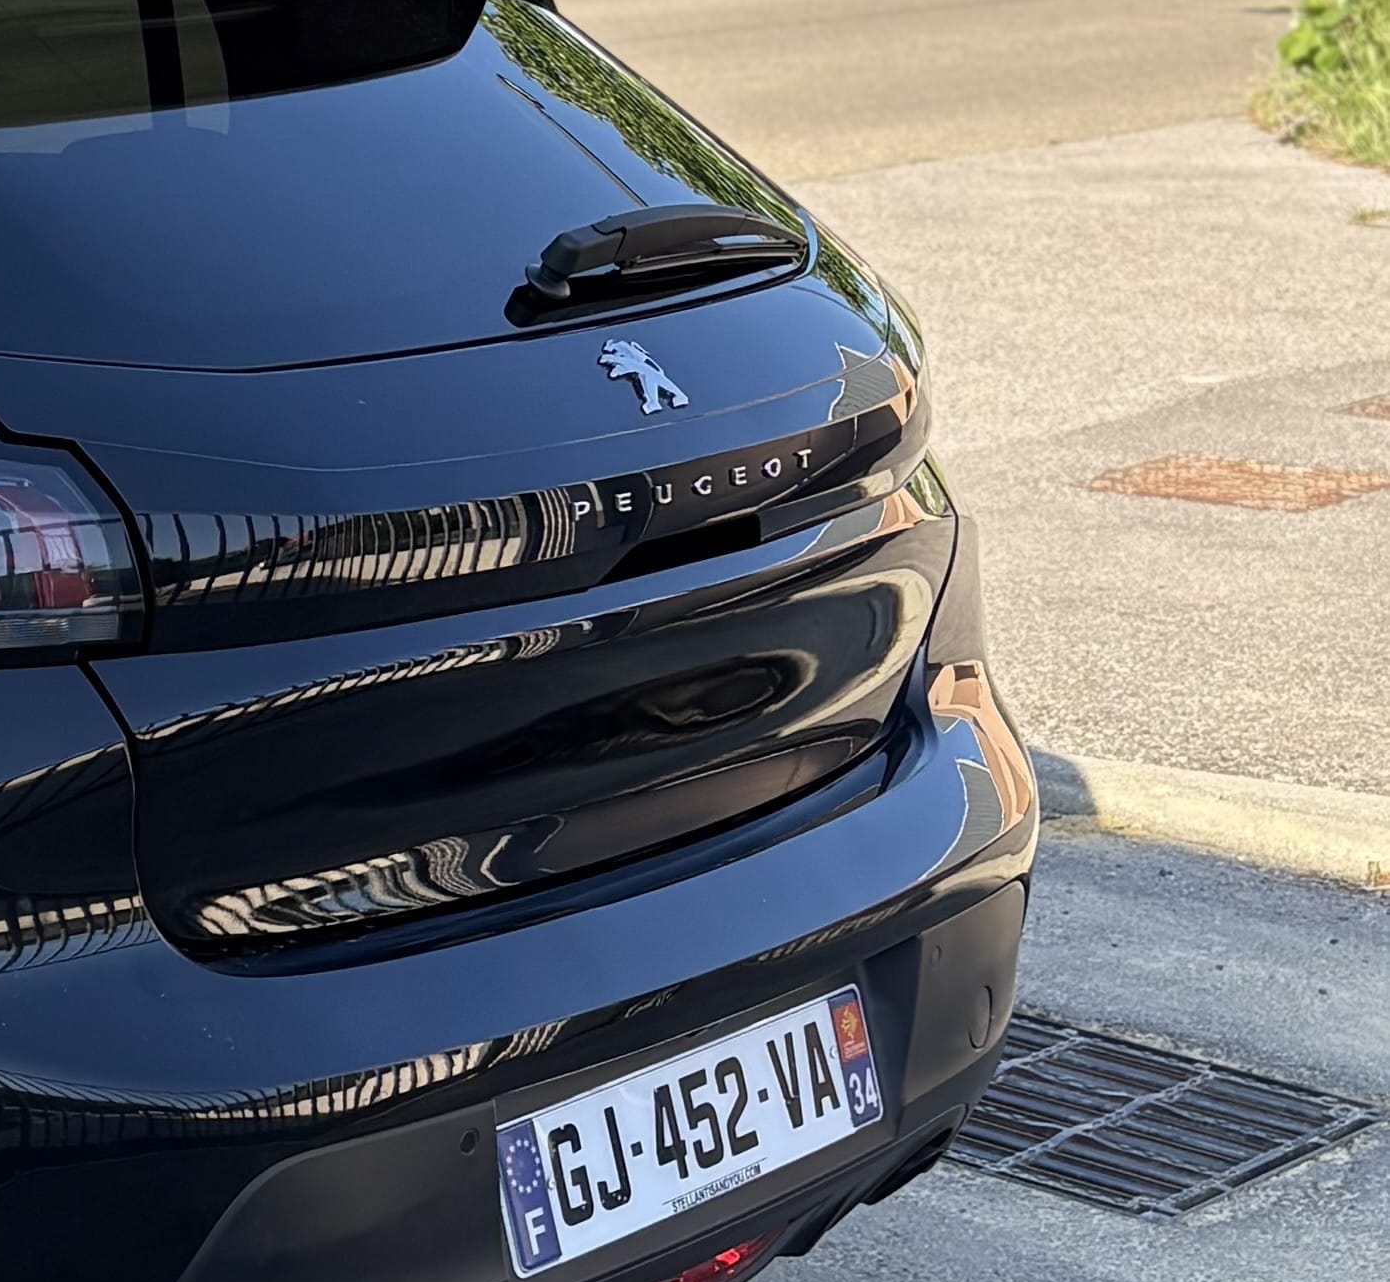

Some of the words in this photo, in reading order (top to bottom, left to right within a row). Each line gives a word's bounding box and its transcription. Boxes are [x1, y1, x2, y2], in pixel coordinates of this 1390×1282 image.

[574, 448, 813, 522] PEUGEOT
[849, 1067, 878, 1115] 34
[547, 1021, 840, 1227] GJ-452-VA
[524, 1206, 546, 1256] F
